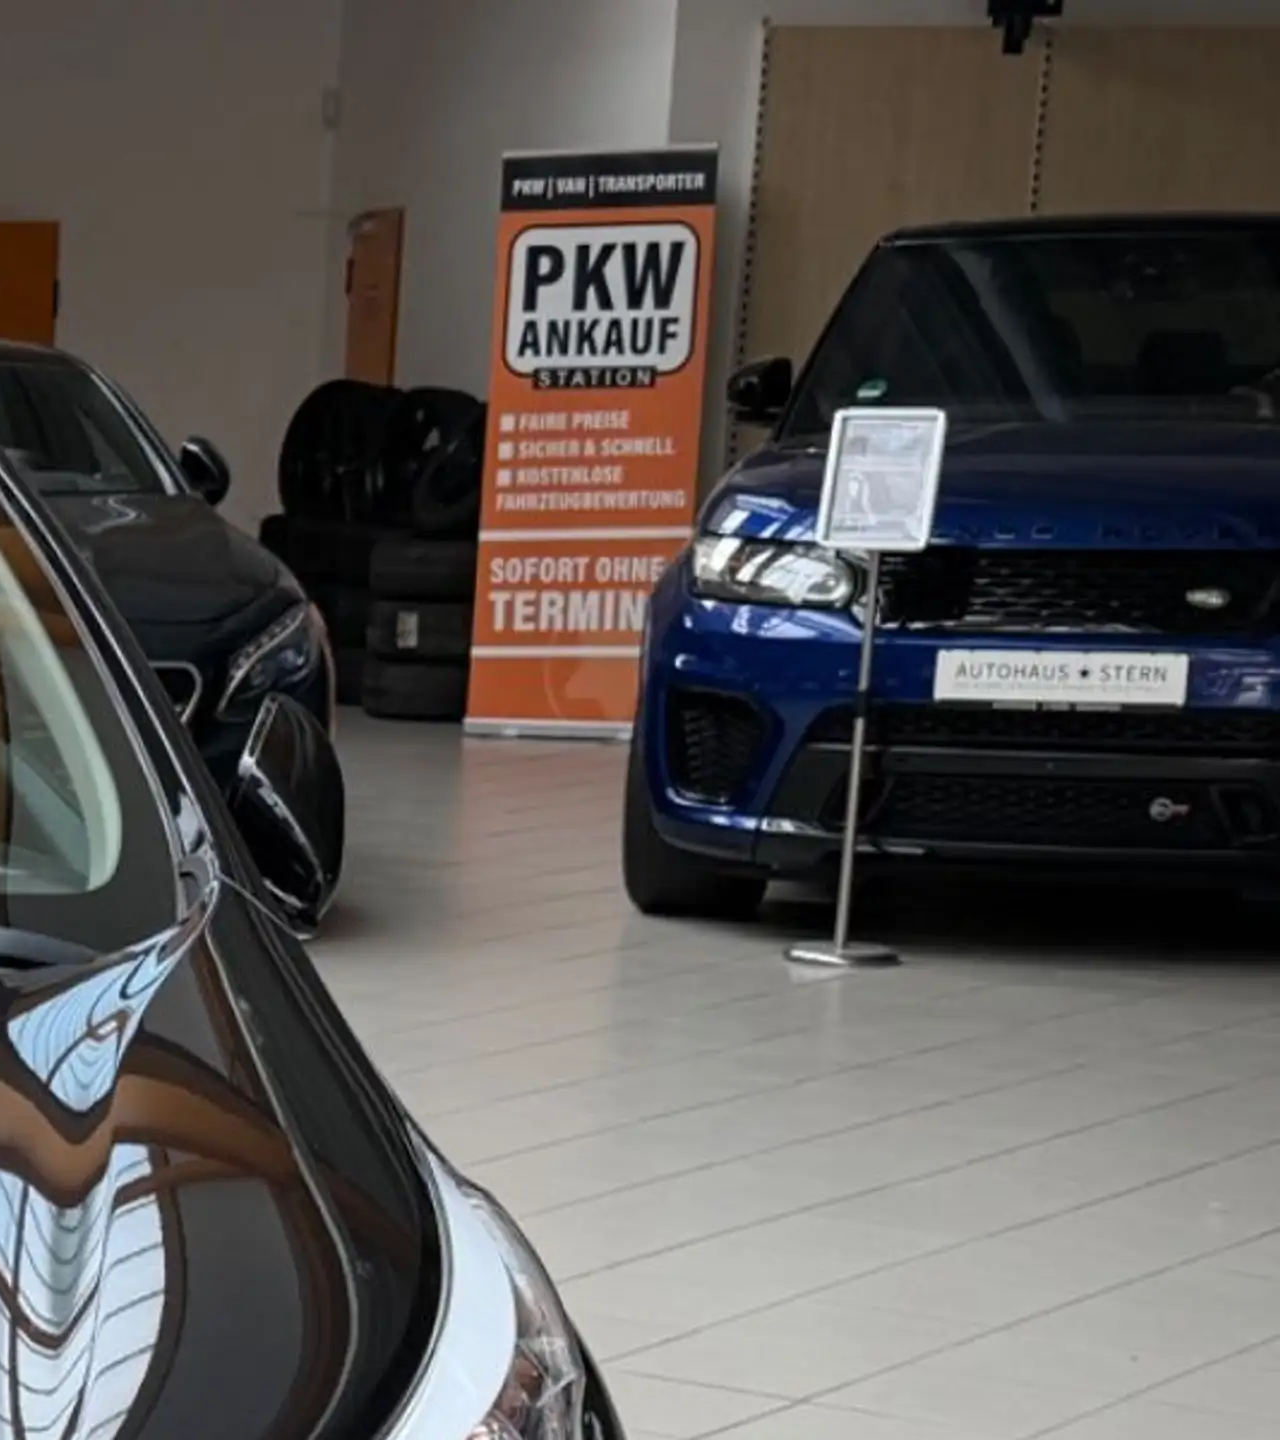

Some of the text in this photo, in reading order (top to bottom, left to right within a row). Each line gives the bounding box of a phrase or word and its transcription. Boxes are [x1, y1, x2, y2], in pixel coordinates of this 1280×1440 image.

[512, 172, 706, 196] PKW VAN TRANSPORTER
[522, 240, 687, 313] PKW
[517, 316, 680, 357] ANKAUF
[537, 368, 651, 388] STATION
[518, 410, 630, 433] FAIRE PREISE
[517, 440, 581, 460] SICHER
[600, 436, 676, 457] SCHNELL
[516, 465, 625, 486] KOSTENLOSE
[495, 489, 686, 511] FAHRZEUGBEWERTUNG
[490, 555, 666, 584] SOFORT OHNE
[487, 589, 650, 632] TERMIN
[954, 661, 1169, 684] AUTOHAUS STERN
